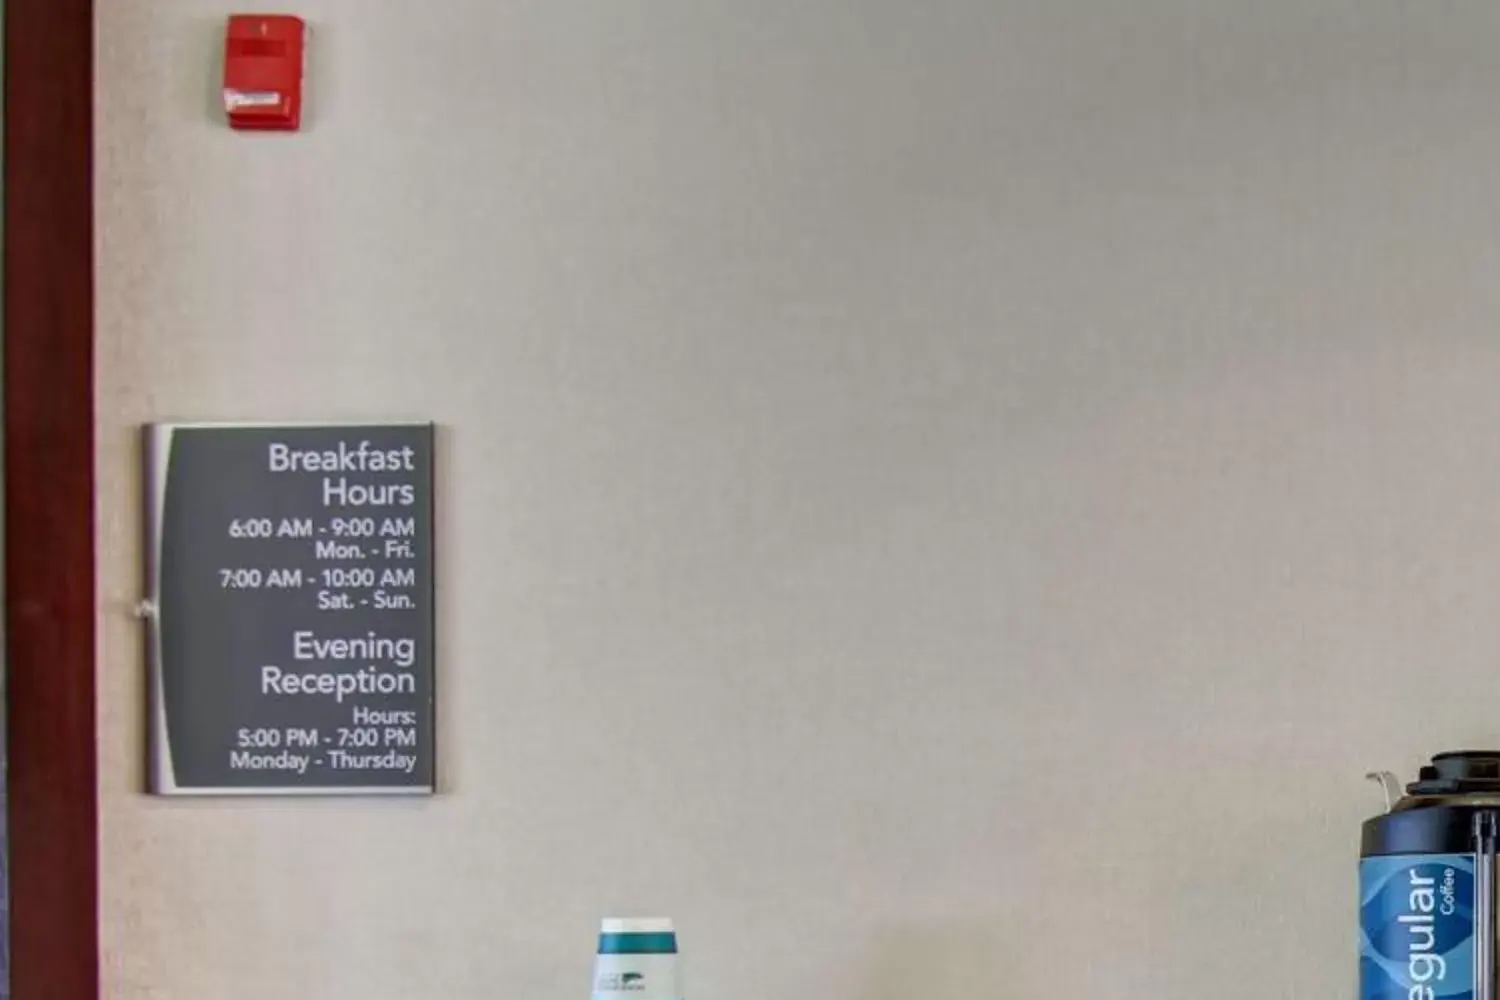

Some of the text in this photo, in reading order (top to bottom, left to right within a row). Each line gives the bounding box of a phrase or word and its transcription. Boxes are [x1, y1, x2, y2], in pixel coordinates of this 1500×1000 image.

[268, 441, 415, 472] Breakfast
[322, 477, 415, 506] Hours
[228, 518, 272, 538] 6:00
[276, 519, 313, 537] AM
[331, 517, 375, 537] 9:00
[379, 518, 415, 537] AM
[315, 541, 366, 560] Mon.
[384, 540, 415, 559] Fri.
[219, 569, 262, 588] 7:00
[266, 570, 302, 588] AM
[323, 569, 375, 587] 10:00
[380, 569, 415, 587] AM
[317, 591, 354, 610] Sat.
[373, 590, 415, 610] Sun.
[293, 631, 415, 667] Evening
[261, 666, 415, 703] Reception
[353, 705, 416, 725] Hours:
[238, 729, 280, 747] 5:00
[286, 729, 318, 747] PM
[337, 728, 379, 747] 7:00
[384, 728, 416, 747] PM
[230, 751, 310, 774] Monday
[328, 750, 416, 774] Thursday
[1439, 867, 1456, 916] Coffee
